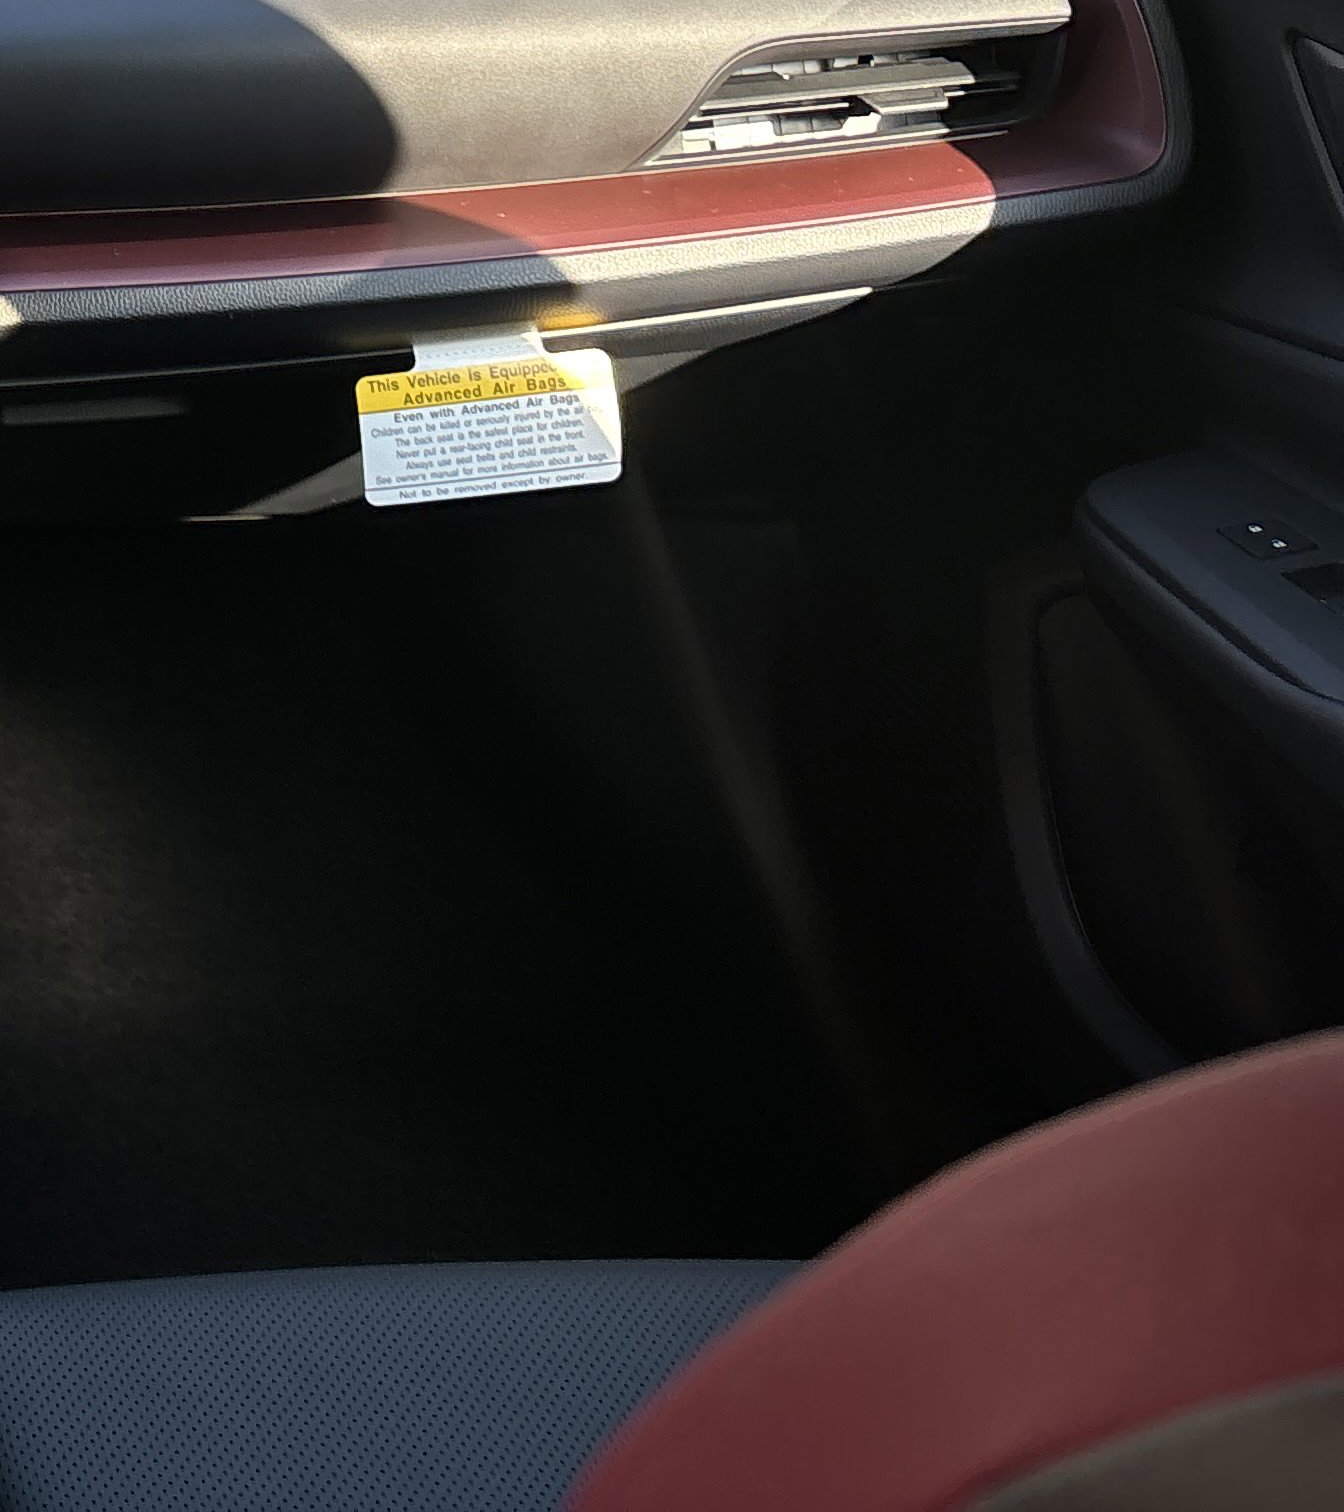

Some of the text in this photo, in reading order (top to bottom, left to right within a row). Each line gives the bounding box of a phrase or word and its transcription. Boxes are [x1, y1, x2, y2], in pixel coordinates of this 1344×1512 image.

[367, 380, 399, 394] This
[407, 372, 461, 389] Vehicle
[403, 377, 566, 406] Advanced Air Bags
[394, 393, 581, 424] Even with Advanced Air Bags
[396, 449, 420, 460] Never
[398, 488, 417, 500] Not
[436, 485, 450, 496] be
[454, 481, 497, 494] removed
[501, 476, 534, 490] except
[538, 475, 550, 486] by
